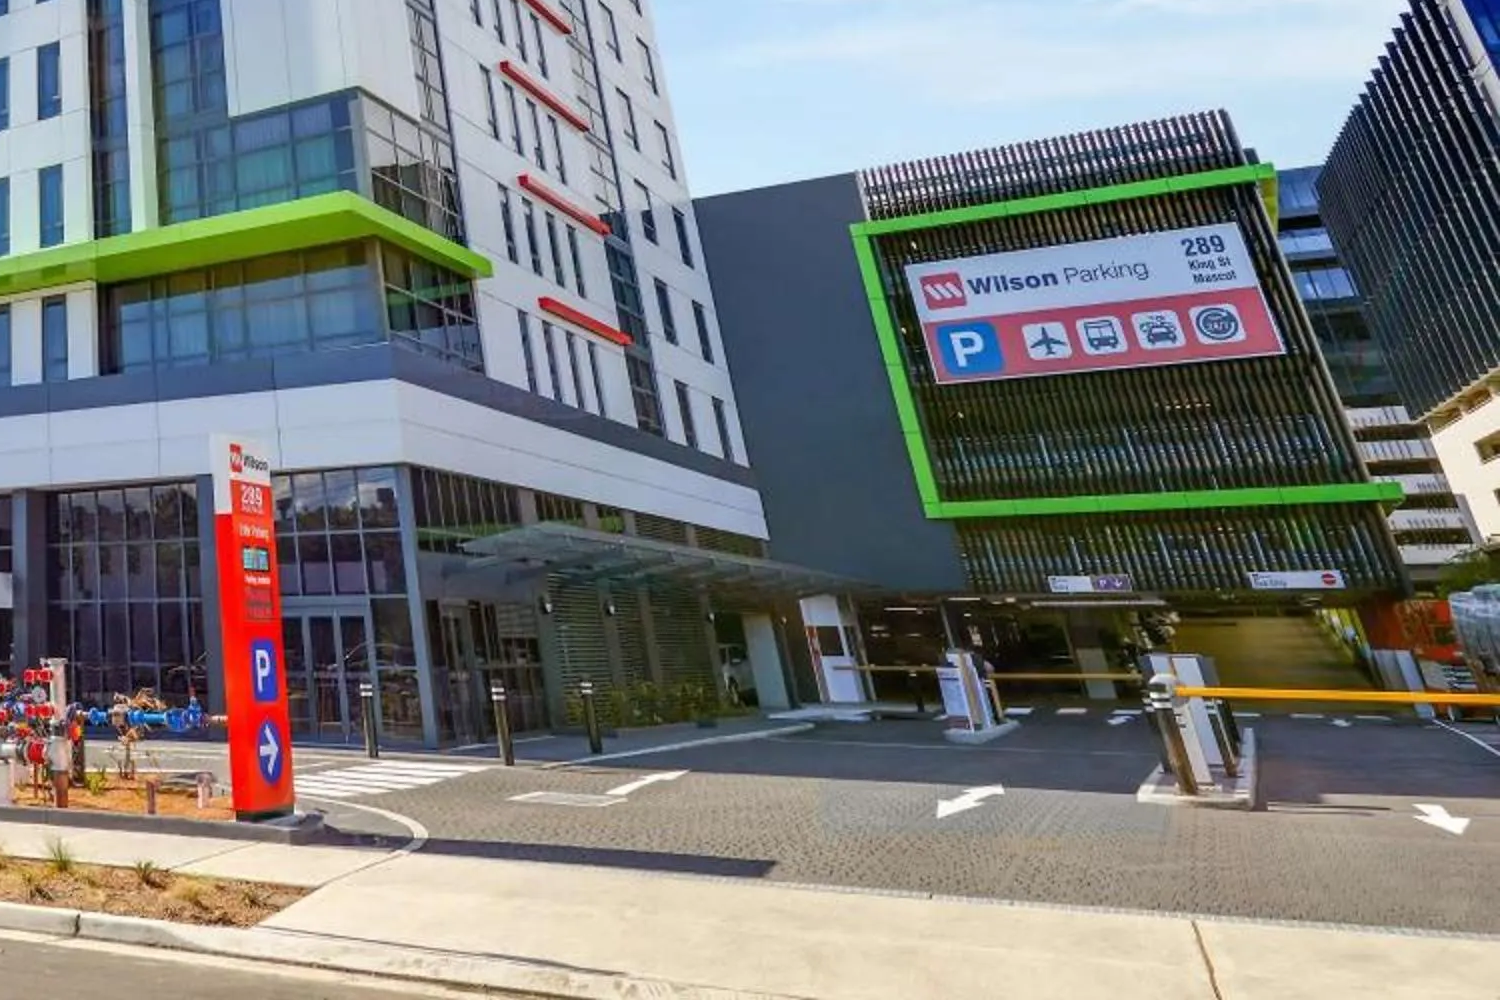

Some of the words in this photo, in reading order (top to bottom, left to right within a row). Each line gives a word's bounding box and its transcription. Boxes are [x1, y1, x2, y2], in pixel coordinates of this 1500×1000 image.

[1181, 234, 1225, 257] 289
[966, 272, 1059, 296] Wilson
[1062, 259, 1149, 284] Parking
[1188, 259, 1216, 271] King
[1192, 270, 1237, 283] Mascot
[949, 331, 985, 368] P
[255, 649, 270, 692] P
